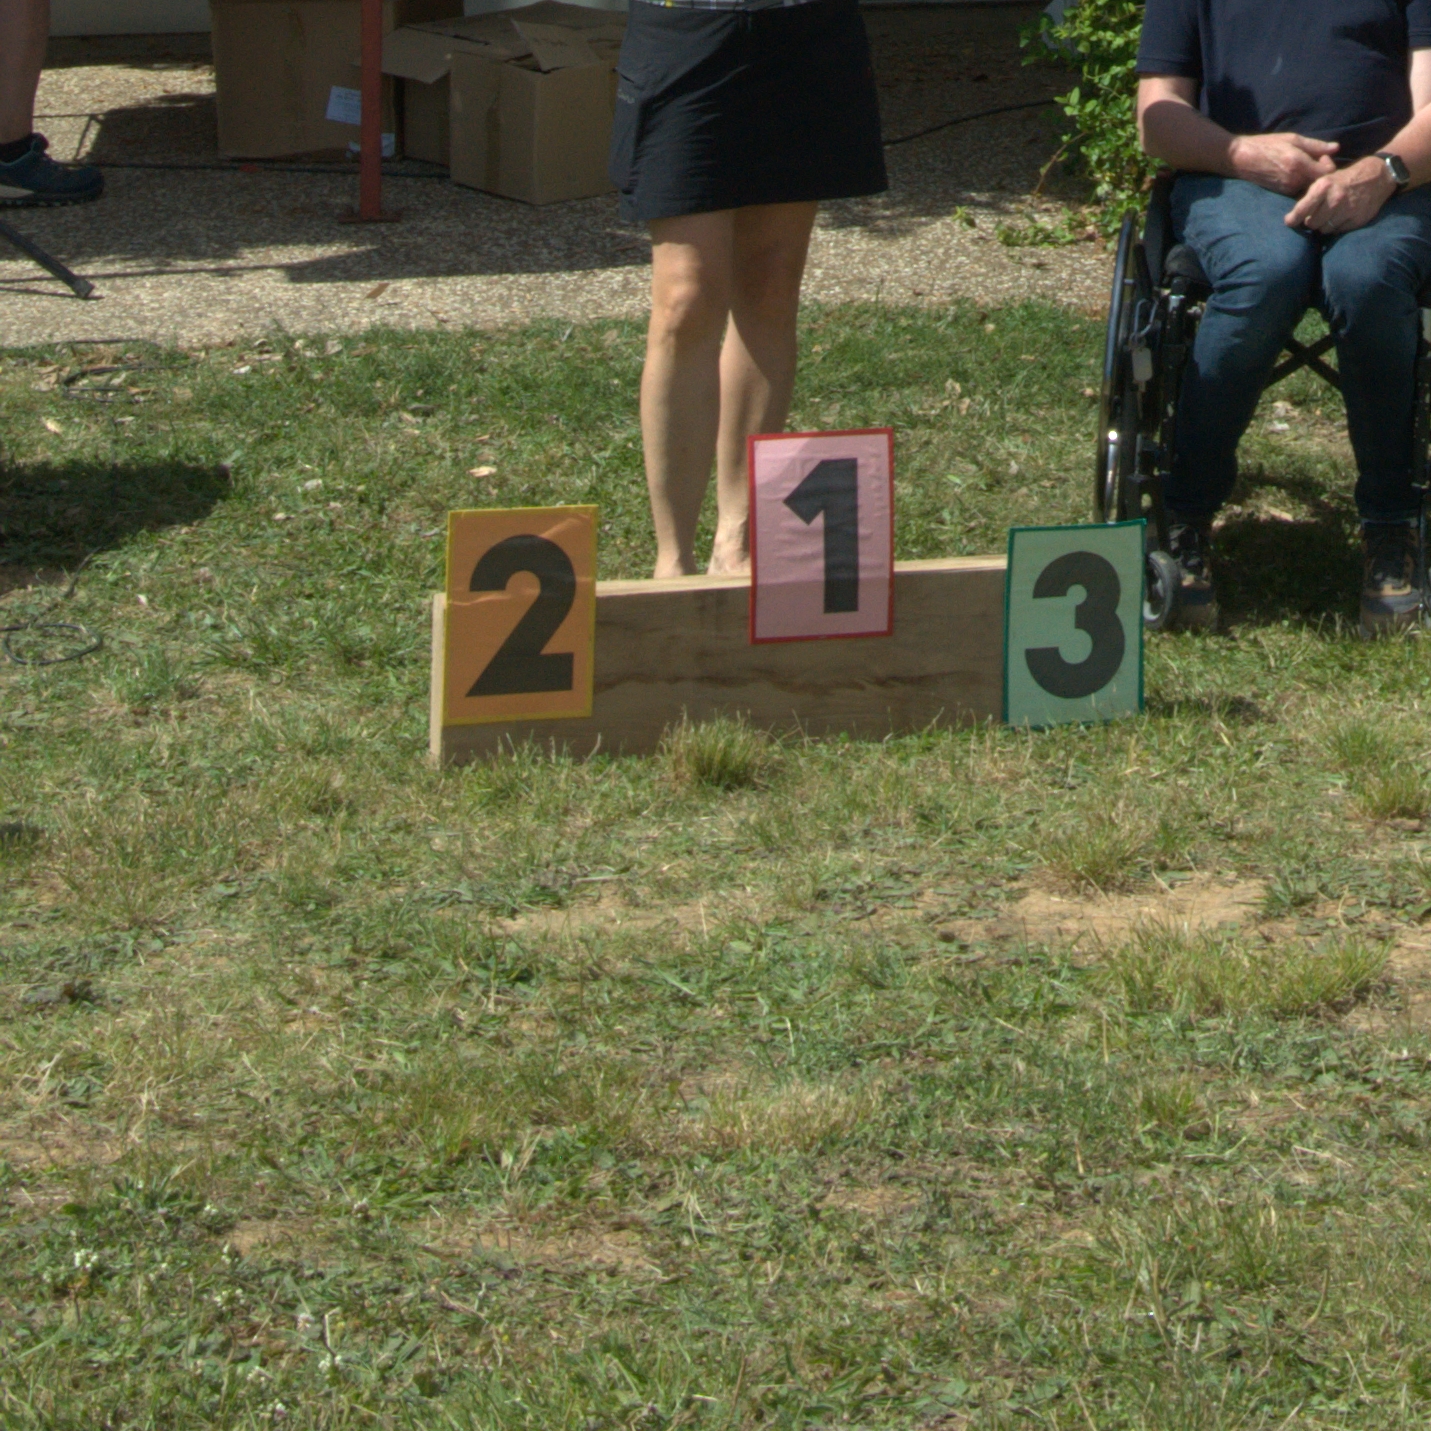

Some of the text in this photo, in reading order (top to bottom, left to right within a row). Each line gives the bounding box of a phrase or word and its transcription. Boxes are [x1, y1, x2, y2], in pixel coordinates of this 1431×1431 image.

[784, 457, 859, 614] 1
[464, 533, 578, 698] 2
[1024, 550, 1126, 699] 3
